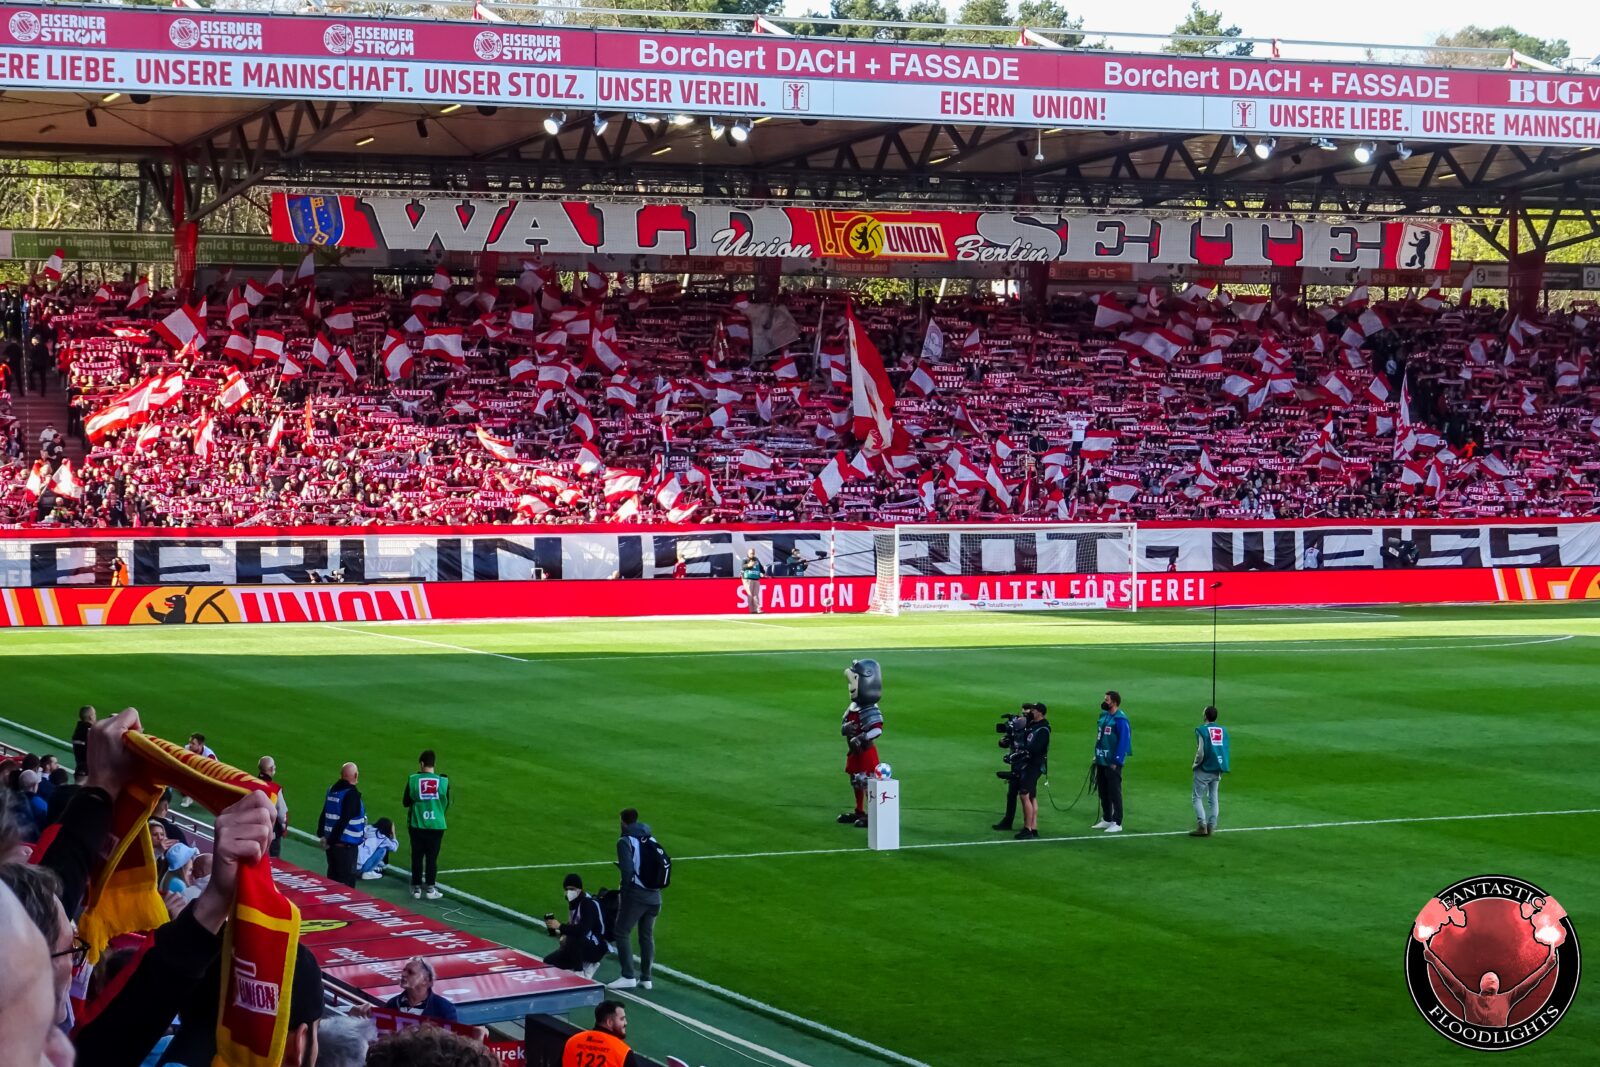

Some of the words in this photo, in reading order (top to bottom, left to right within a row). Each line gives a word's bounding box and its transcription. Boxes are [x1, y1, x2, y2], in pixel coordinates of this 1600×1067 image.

[41, 14, 105, 29] EISERNER
[200, 21, 262, 36] EISERNER
[41, 28, 106, 44] STROM
[200, 35, 263, 50] STROM
[354, 26, 414, 41] EISERNER
[503, 35, 560, 49] EISERNER
[354, 40, 414, 55] STROM
[503, 46, 561, 62] STROM
[639, 39, 766, 70] Borchert
[776, 48, 856, 74] DACH
[865, 58, 881, 75] +
[890, 53, 1019, 81] FASSADE
[47, 55, 124, 83] LIEBE.
[136, 59, 232, 87] UNSERE
[243, 63, 413, 93] MANNSCHAFT.
[424, 69, 501, 97] UNSER
[508, 73, 585, 99] STOLZ.
[599, 77, 672, 104] UNSER
[679, 80, 766, 107] VEREIN.
[1104, 61, 1220, 90] Borchert
[1229, 68, 1301, 92] DACH
[1309, 77, 1323, 93] +
[1332, 72, 1450, 99] FASSADE
[1508, 79, 1584, 104] BUG
[941, 91, 1015, 117] EISERN
[1033, 95, 1107, 120] UNION!
[1270, 104, 1345, 129] UNSERE
[1350, 107, 1409, 132] LIEBE.
[1422, 111, 1496, 135] UNSERE
[1504, 113, 1600, 139] MANNSCH
[65, 238, 110, 248] niemals
[713, 229, 814, 258] Union
[884, 225, 945, 254] UNION
[954, 234, 1050, 262] Berlin
[736, 583, 853, 609] STADION
[1071, 575, 1205, 602] FÖRSTEREI
[422, 810, 437, 820] 01
[240, 979, 276, 1011] UNION
[576, 1050, 607, 1067] 122
